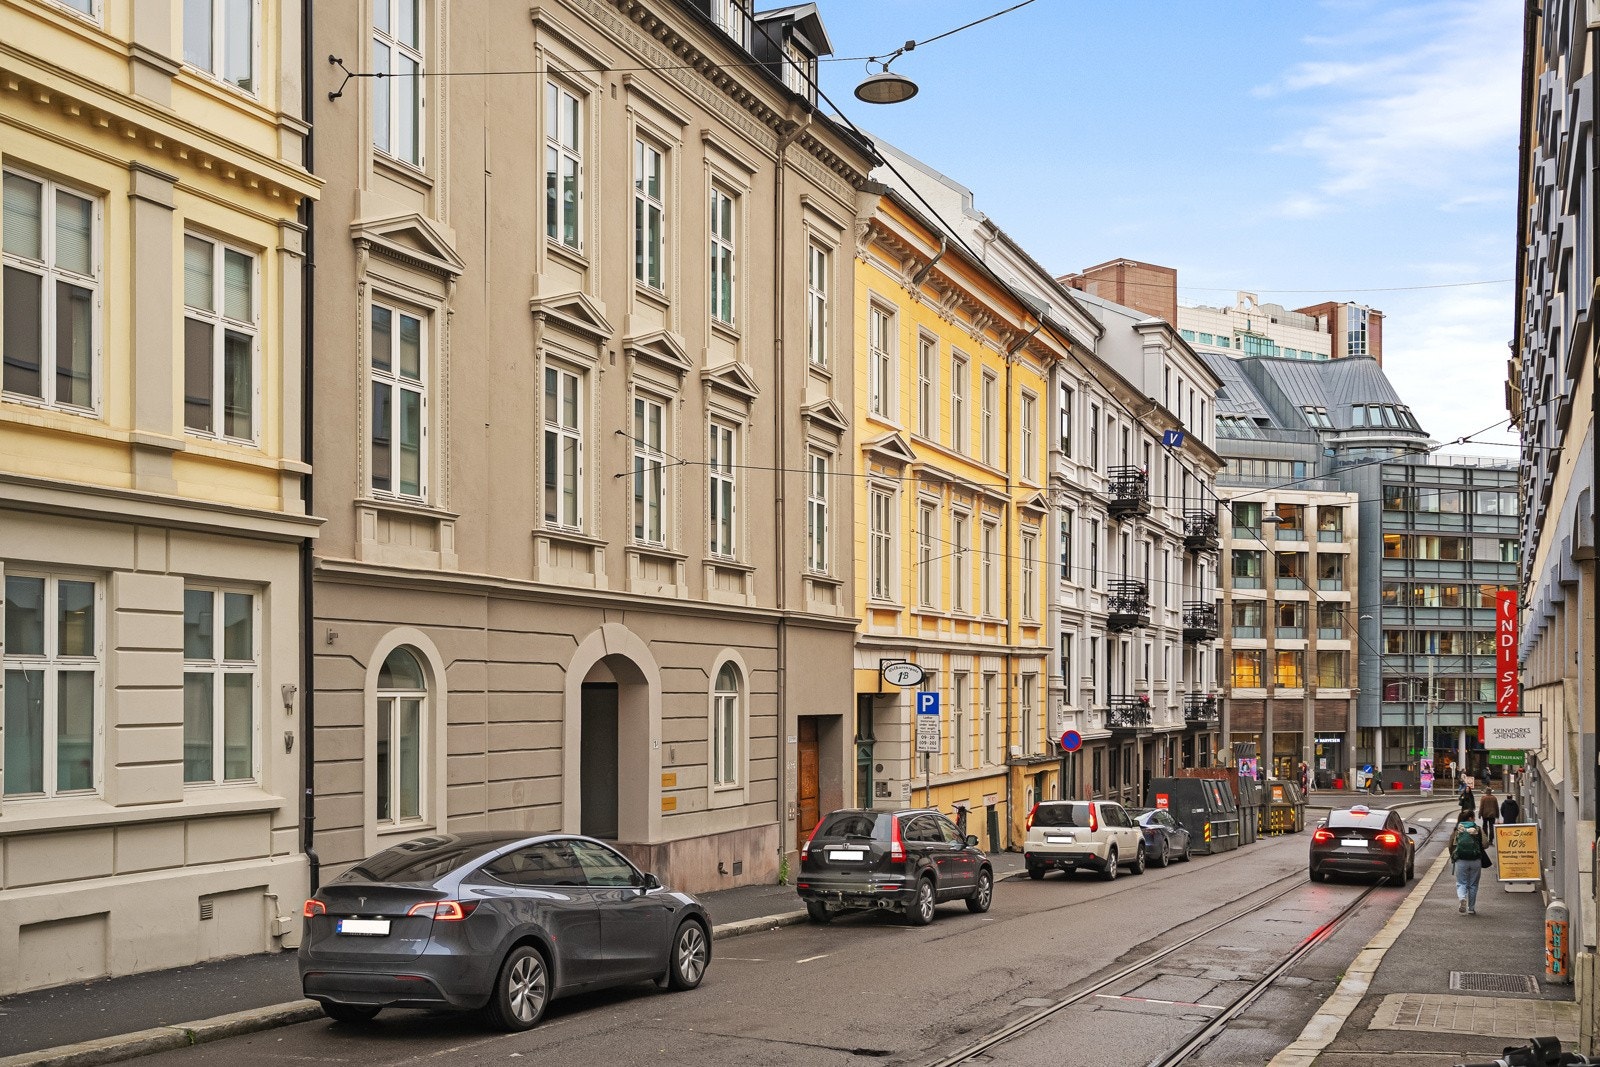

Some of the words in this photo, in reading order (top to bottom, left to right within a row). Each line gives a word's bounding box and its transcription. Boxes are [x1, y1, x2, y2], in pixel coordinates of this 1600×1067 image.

[922, 695, 934, 712] P
[1493, 727, 1531, 735] SKINWORKS
[1508, 839, 1527, 848] 10%
